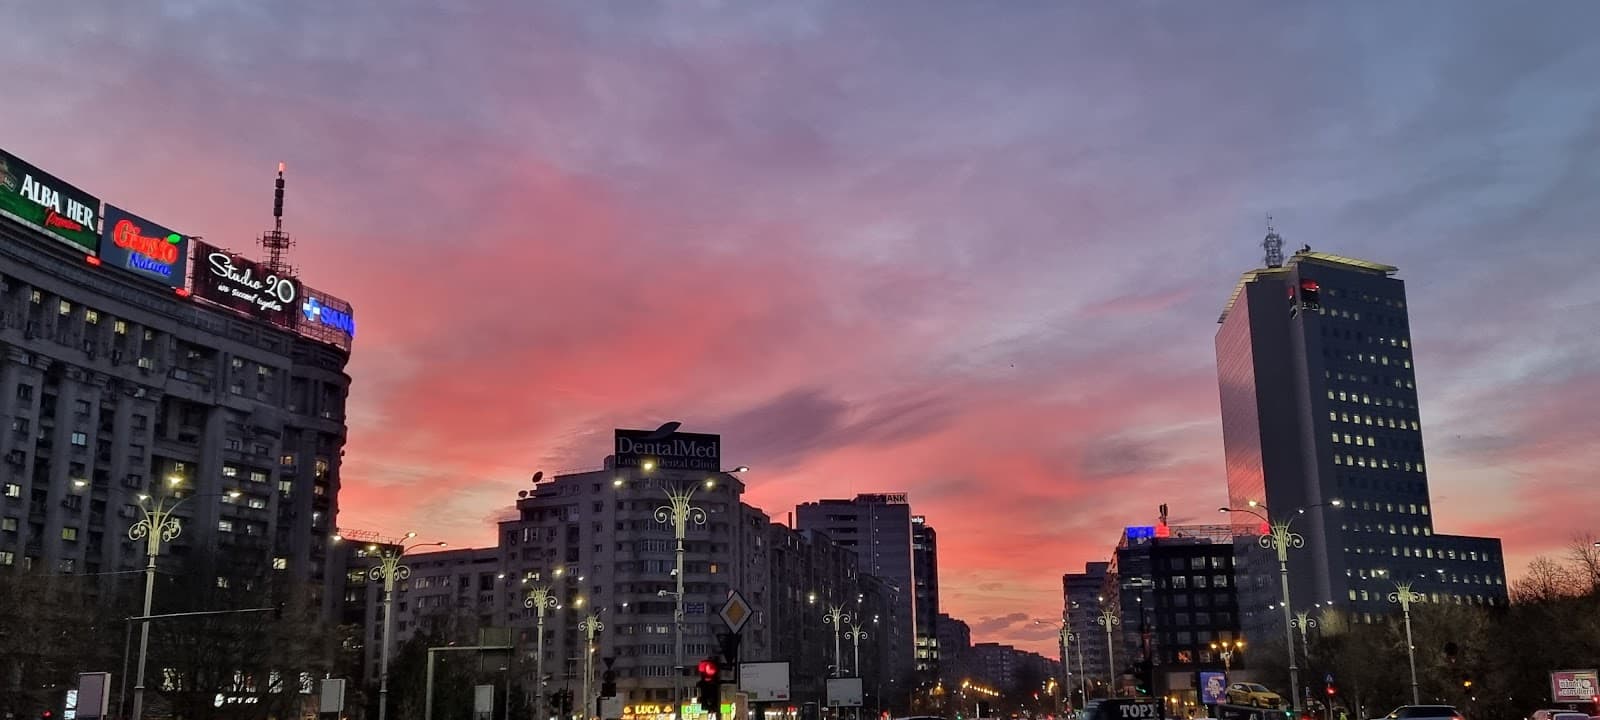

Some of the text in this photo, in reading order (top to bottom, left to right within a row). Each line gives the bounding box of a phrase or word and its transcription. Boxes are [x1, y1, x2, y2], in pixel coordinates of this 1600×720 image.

[209, 252, 295, 304] Studio 20
[617, 436, 718, 458] DentalMed
[656, 457, 688, 470] Dental
[635, 704, 661, 714] LUCA
